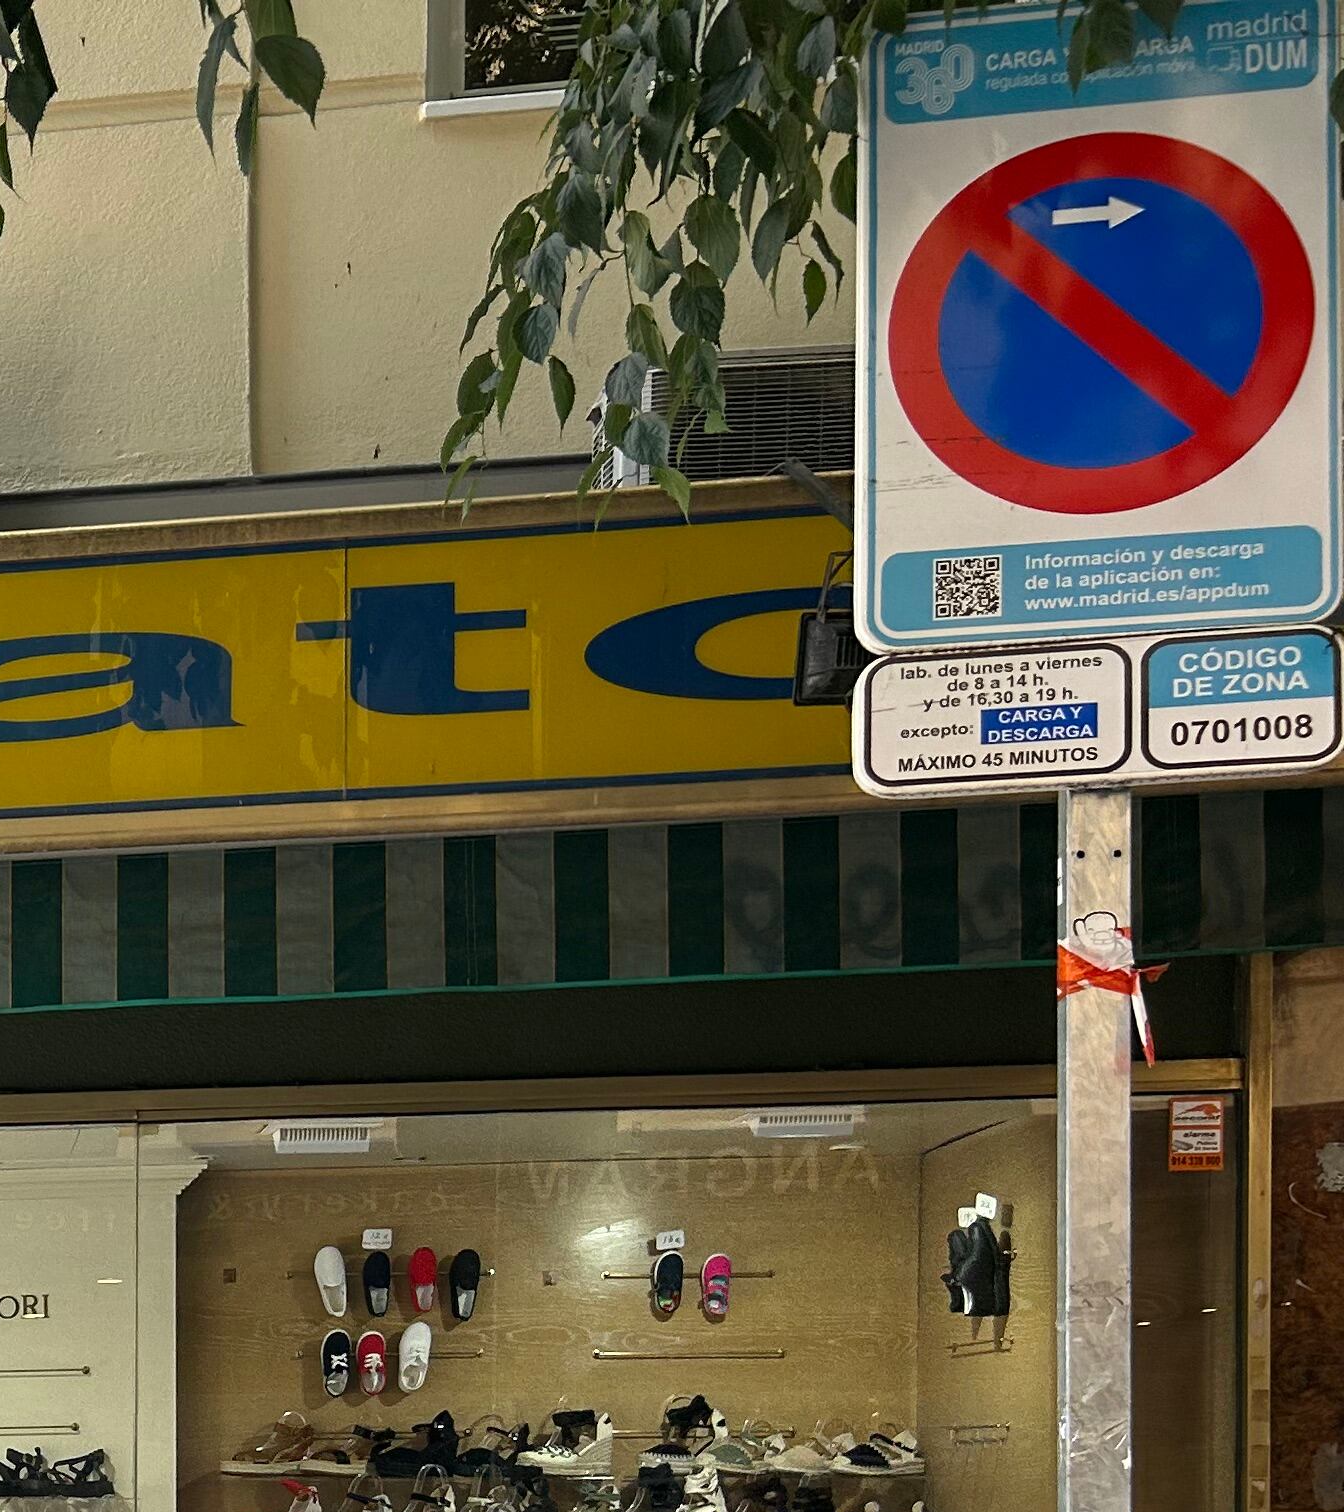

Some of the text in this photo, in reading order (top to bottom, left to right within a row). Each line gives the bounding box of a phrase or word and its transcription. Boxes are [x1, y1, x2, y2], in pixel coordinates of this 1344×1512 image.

[1206, 9, 1308, 41] madrid
[895, 39, 945, 57] MADRID
[985, 48, 1057, 72] CARGA
[1245, 39, 1308, 74] DUM
[985, 72, 1048, 92] regulada
[1051, 72, 1070, 84] co
[1025, 543, 1265, 569] Información y descarga
[1024, 565, 1222, 591] de la aplicación en:
[1024, 581, 1270, 612] www.madrid.es/appdum
[900, 655, 1103, 680] lab. de lunes a viernes
[1178, 645, 1302, 673] CÓDIGO
[947, 674, 1049, 692] de 8 a 14 h.
[1173, 670, 1310, 698] DE ZONA
[922, 687, 1079, 713] y de 16,30 a 19 h.
[998, 706, 1084, 725] CARGA Y
[900, 723, 1094, 744] excepto: DESCARGA
[1170, 713, 1314, 747] 0701008
[898, 747, 1099, 773] MÁXIMO 45 MINUTOS
